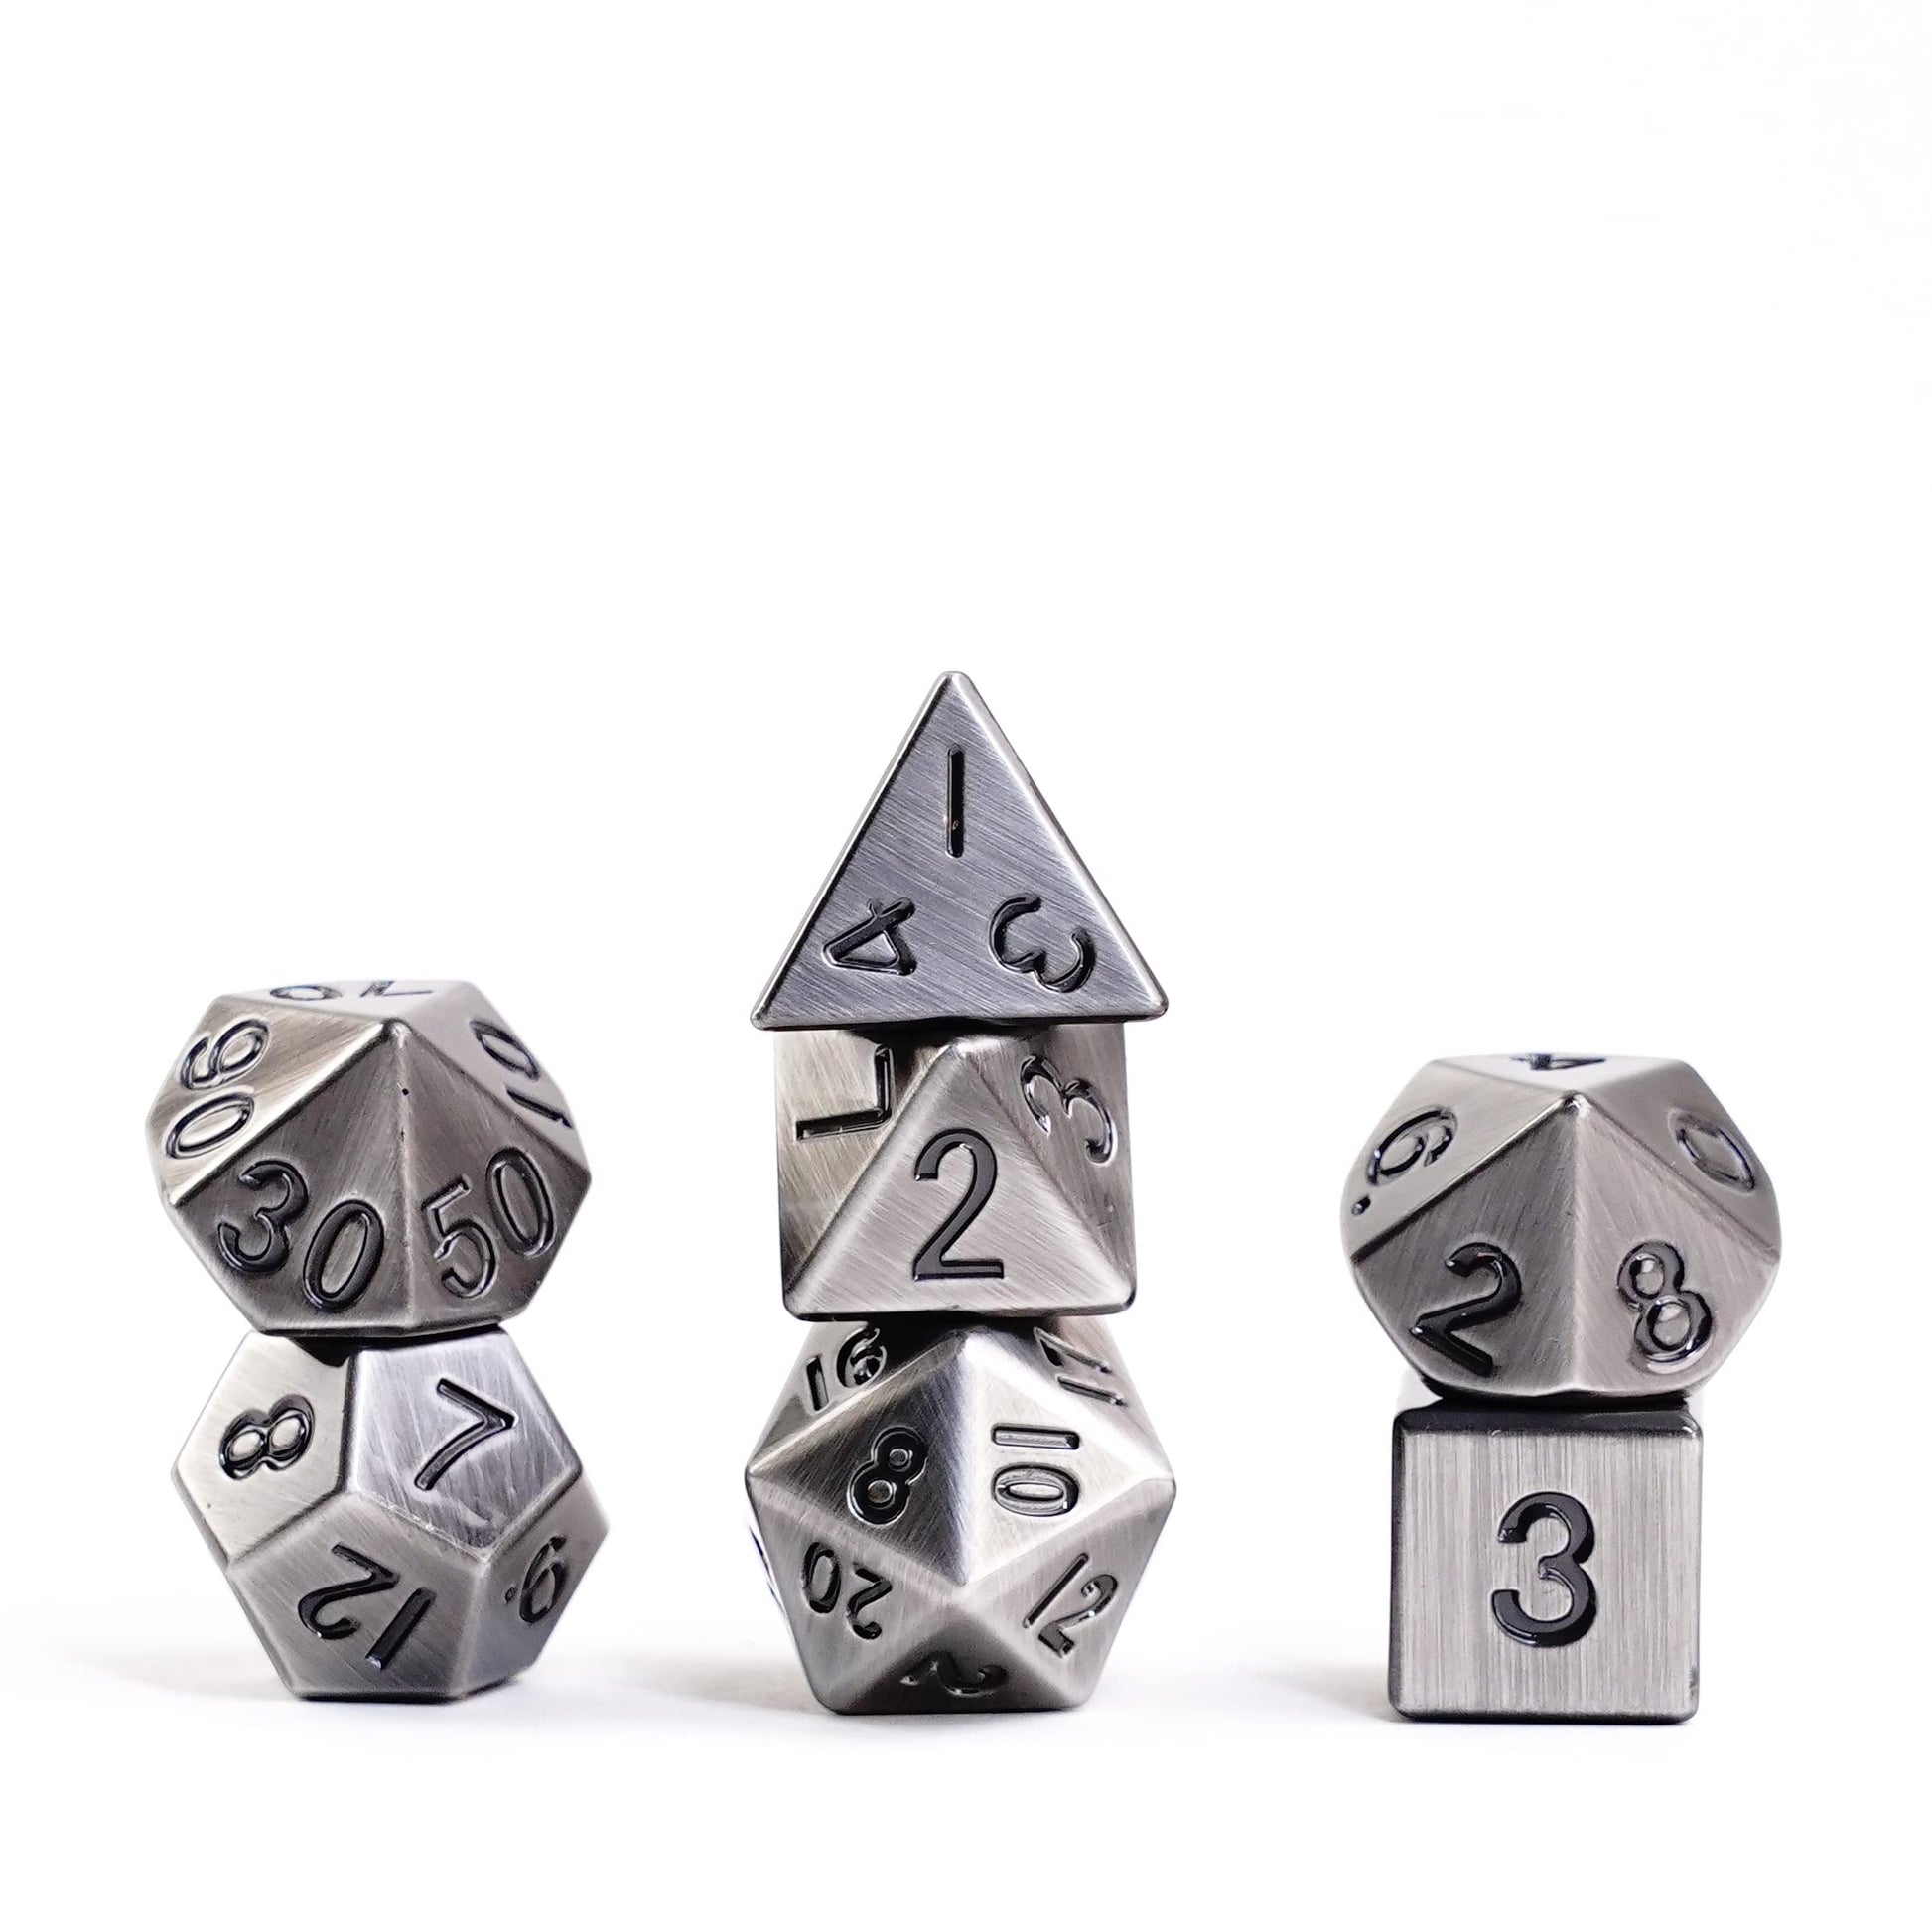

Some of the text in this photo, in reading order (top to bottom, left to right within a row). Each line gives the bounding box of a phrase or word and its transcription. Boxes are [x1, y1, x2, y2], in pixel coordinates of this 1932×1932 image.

[946, 743, 966, 858] 1
[822, 896, 917, 976] 4
[989, 894, 1097, 994] 3
[1020, 1054, 1116, 1166] 3
[216, 1159, 386, 1314] 30
[420, 1145, 556, 1299] 50
[912, 1127, 1005, 1281] 2
[1411, 1241, 1523, 1378] 2
[1616, 1240, 1715, 1373] 8
[804, 1326, 888, 1412] 16
[218, 1393, 316, 1481] 8
[414, 1377, 517, 1491] 7
[847, 1426, 929, 1526] 8
[991, 1423, 1082, 1517] 10
[298, 1543, 438, 1670] 12
[801, 1541, 894, 1640] 20
[1022, 1553, 1119, 1659] 12
[1491, 1491, 1597, 1648] 3
